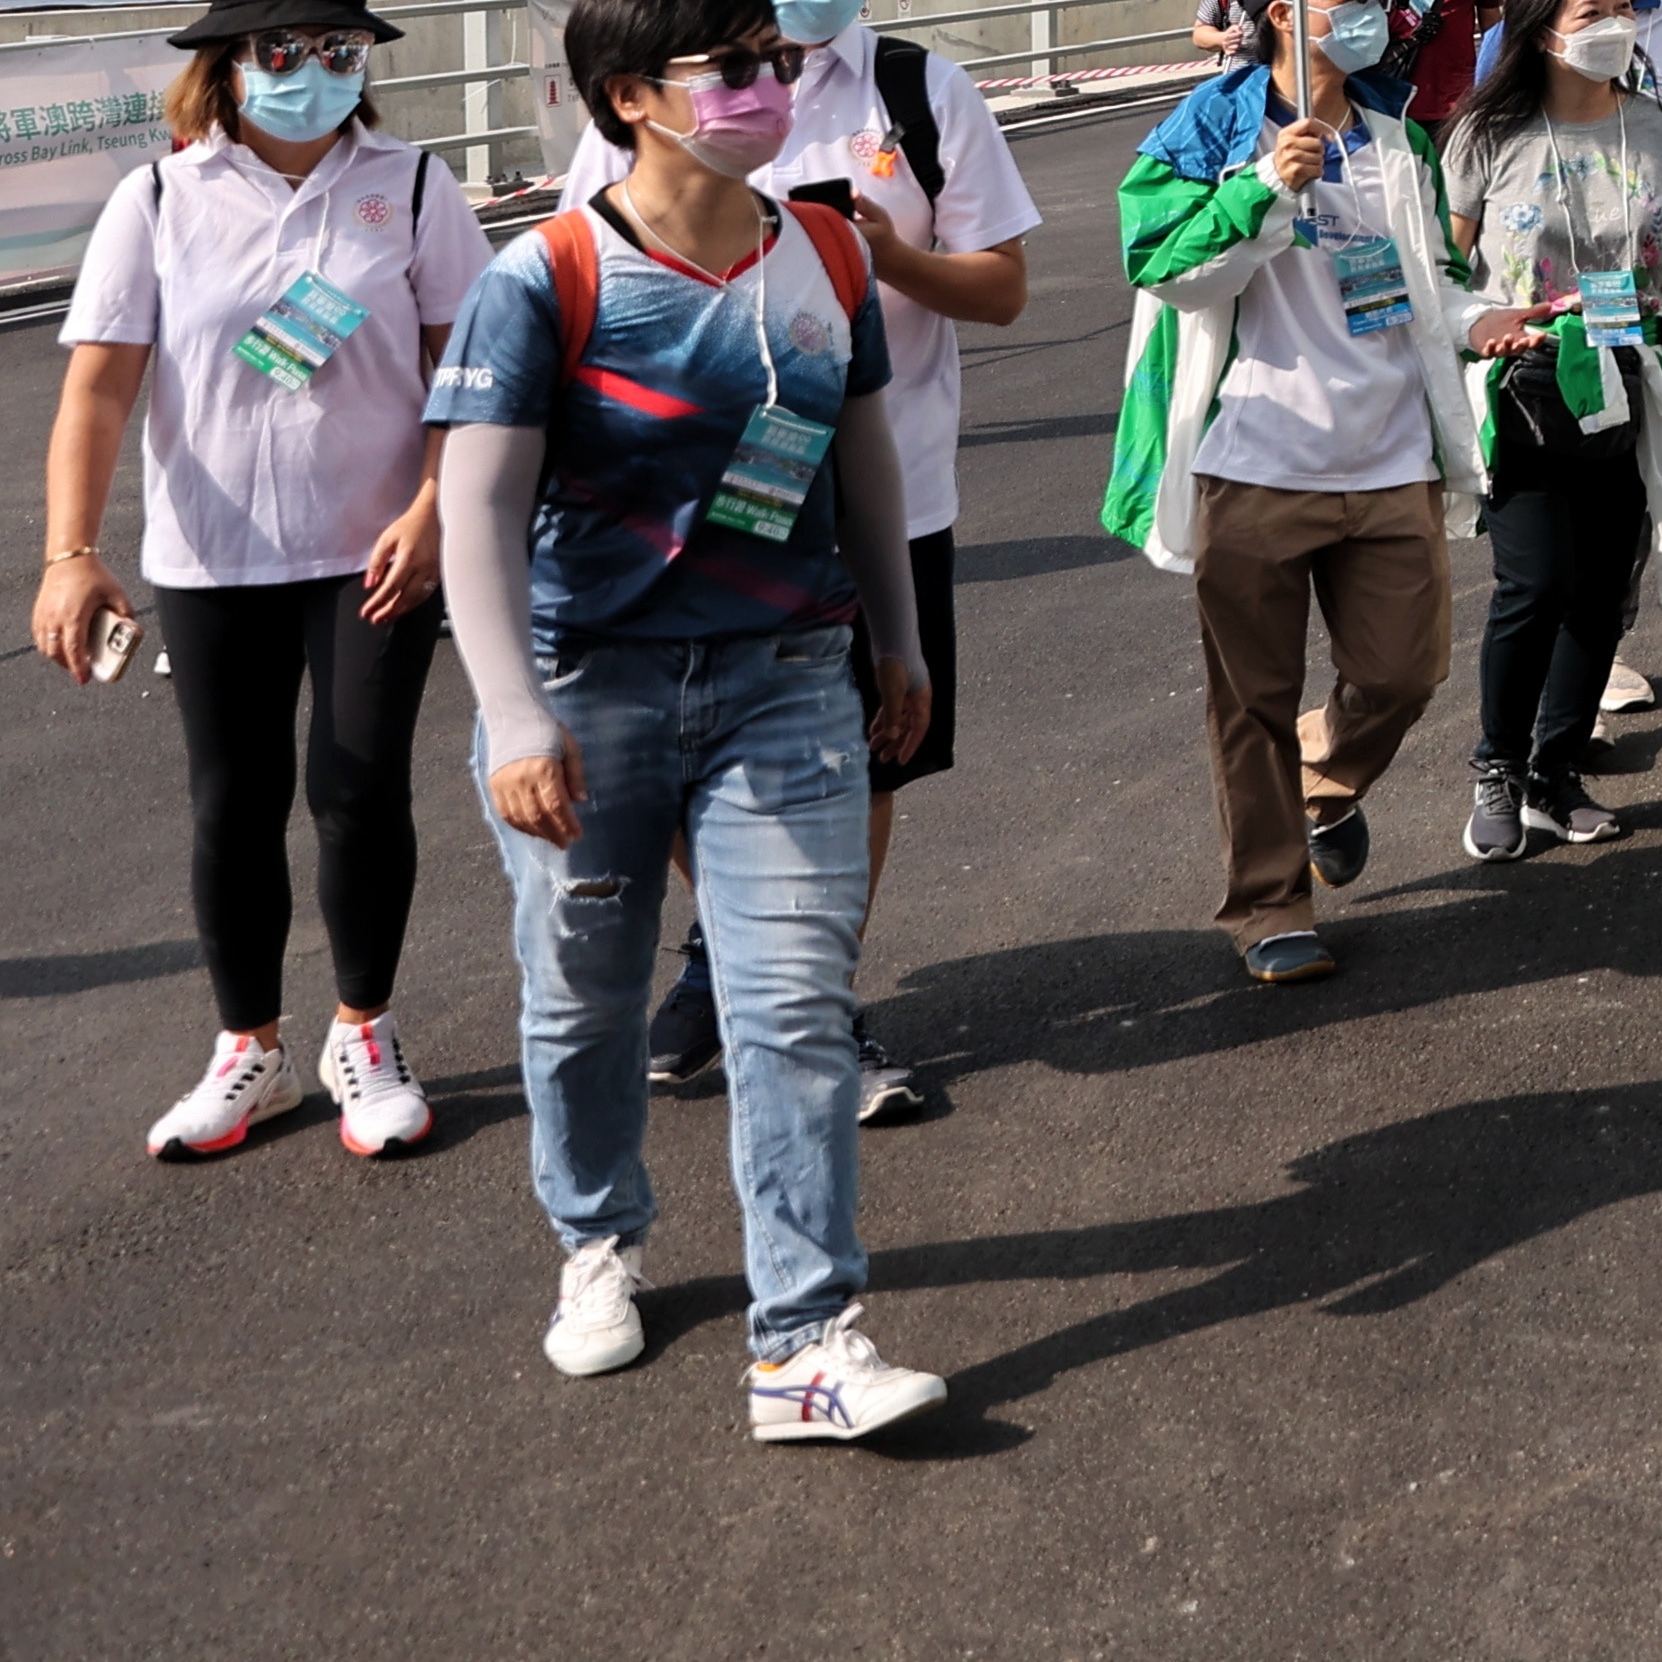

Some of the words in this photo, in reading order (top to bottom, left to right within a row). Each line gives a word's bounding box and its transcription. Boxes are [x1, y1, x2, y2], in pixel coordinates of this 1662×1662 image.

[31, 144, 57, 163] Bay
[60, 138, 93, 156] Link,
[97, 131, 147, 151] Tseung
